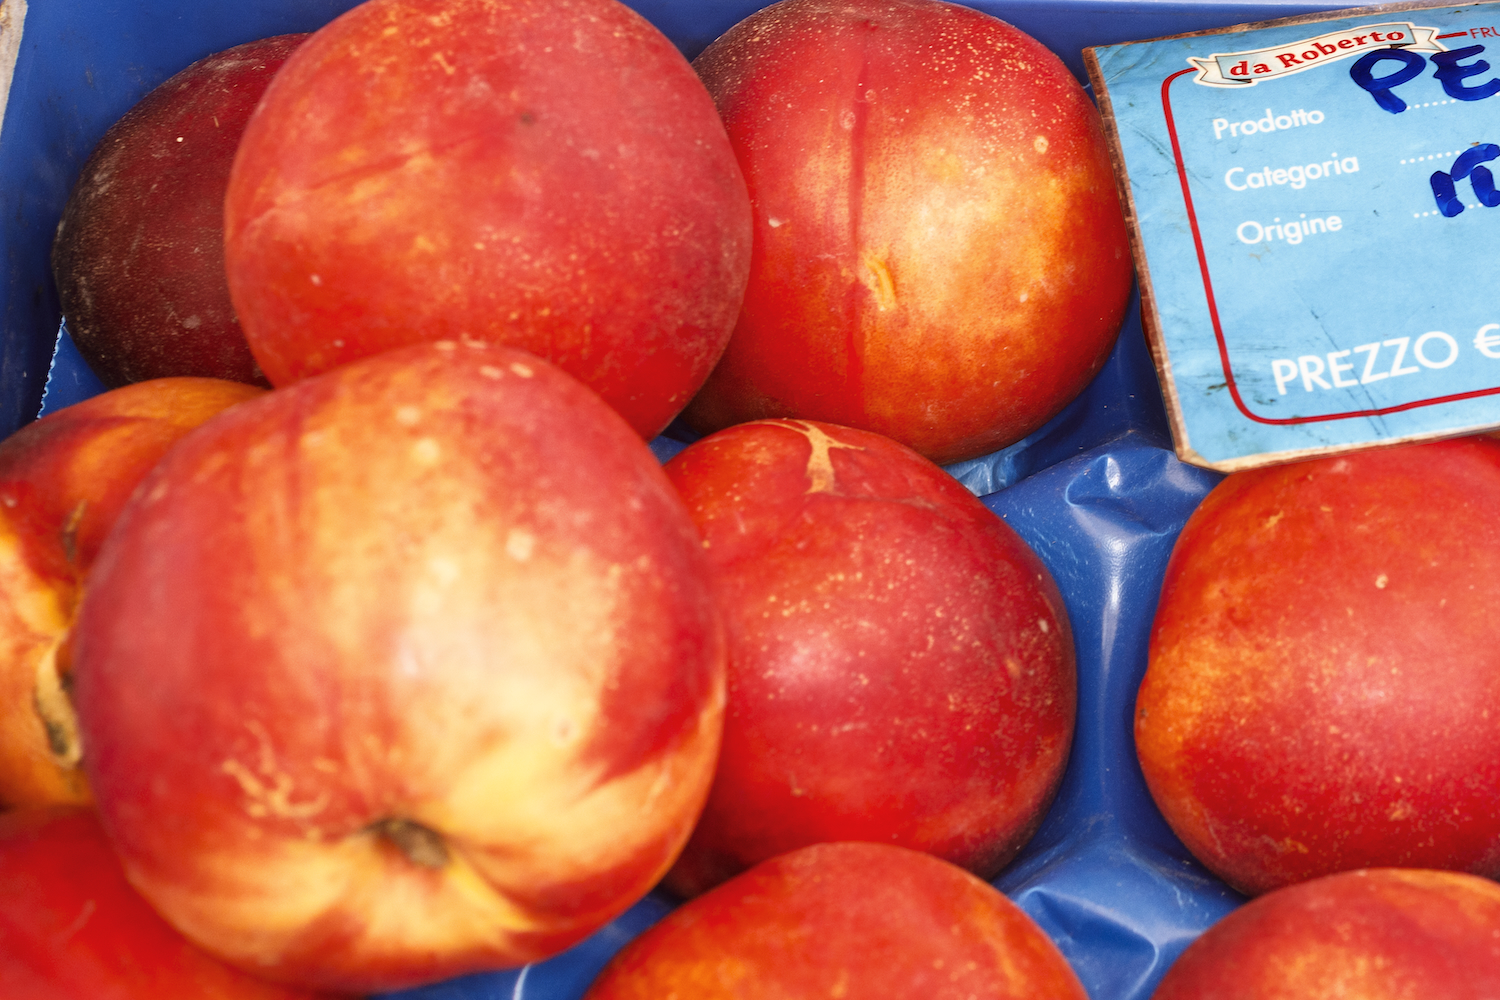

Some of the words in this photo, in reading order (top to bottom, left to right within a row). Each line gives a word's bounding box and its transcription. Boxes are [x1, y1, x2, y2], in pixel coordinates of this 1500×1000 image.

[1229, 60, 1271, 77] da
[1275, 29, 1405, 70] Roberto
[1212, 108, 1326, 140] Prodotto
[1224, 152, 1360, 190] Categoria
[1236, 212, 1344, 245] Origine
[1271, 330, 1459, 396] PREZZO
